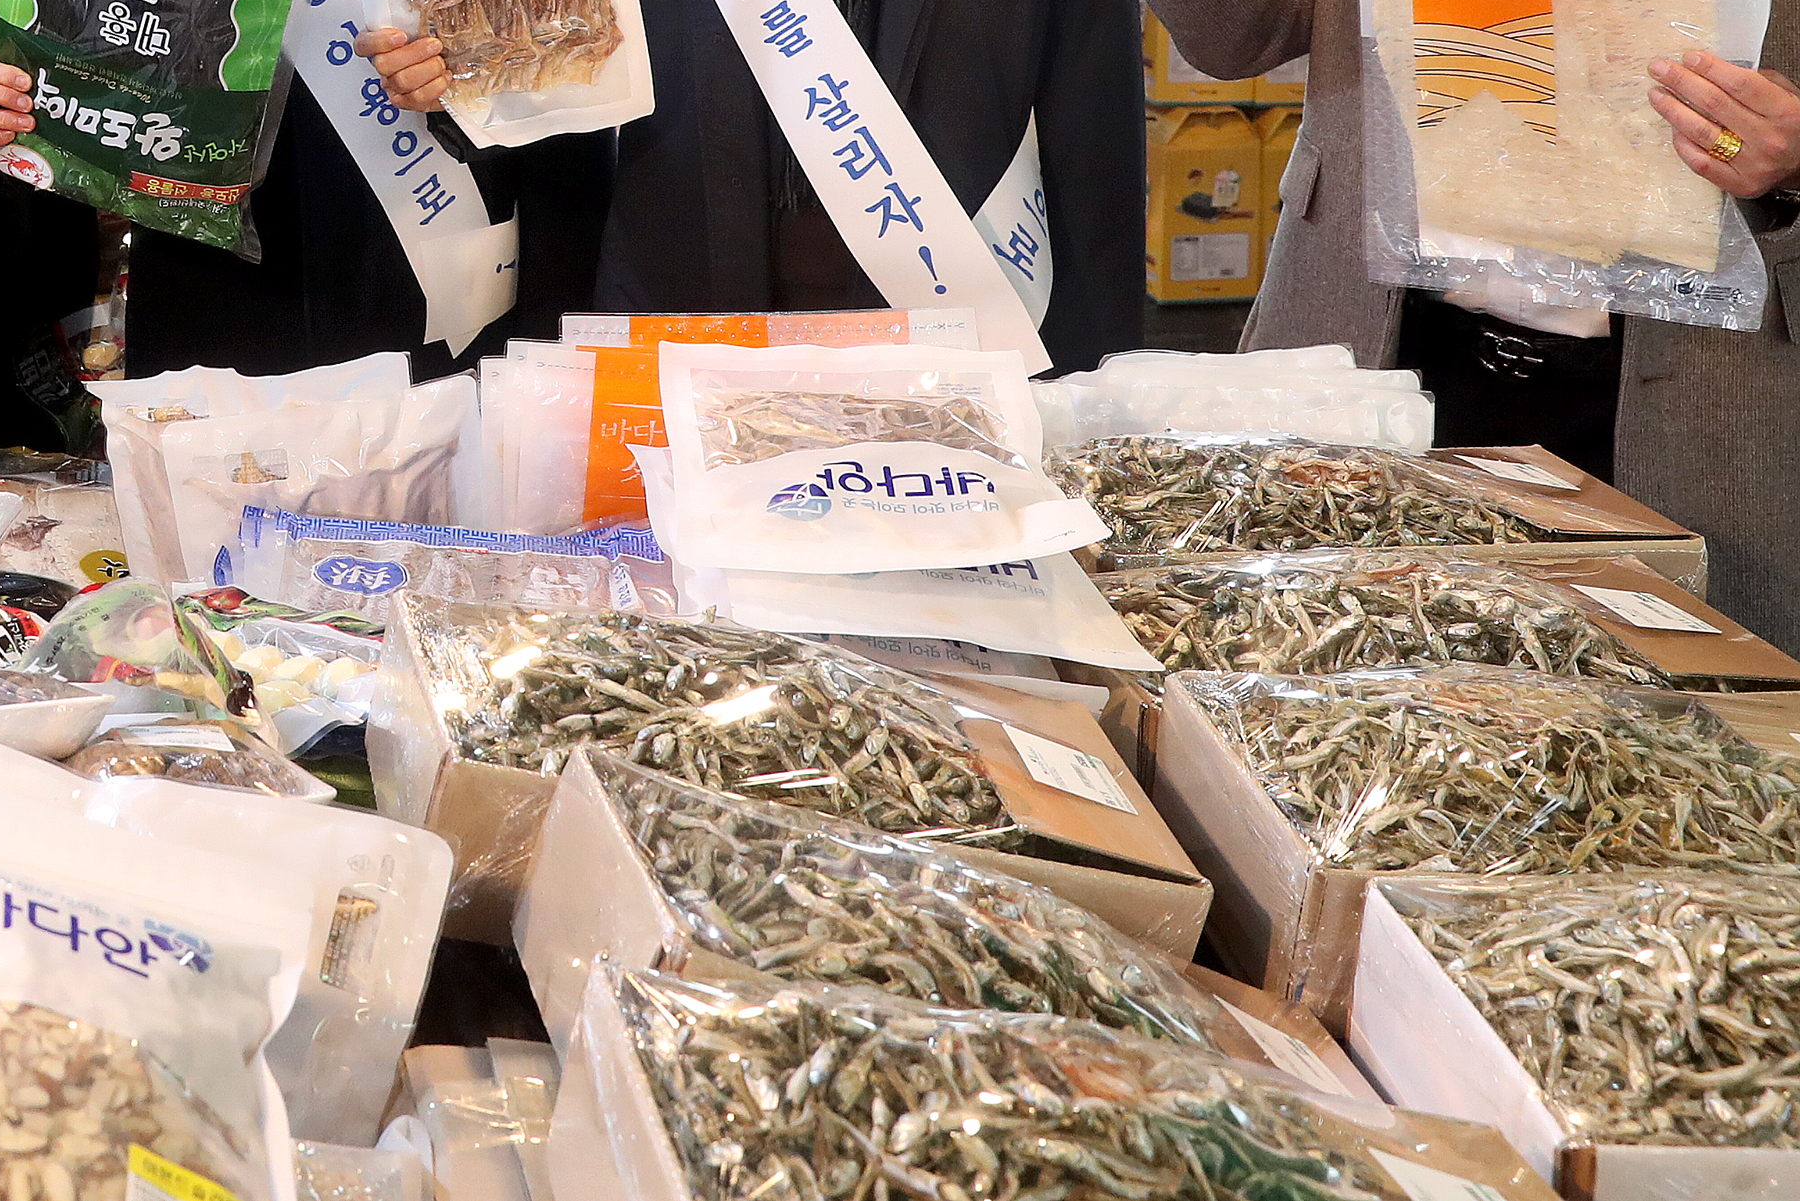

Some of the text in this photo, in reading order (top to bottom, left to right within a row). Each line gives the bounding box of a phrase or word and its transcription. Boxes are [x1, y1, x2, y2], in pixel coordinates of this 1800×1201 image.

[90, 74, 118, 90] Dried
[32, 66, 185, 163] 완도미역
[182, 138, 249, 164] 자연산
[142, 179, 189, 197] 선물용
[803, 72, 949, 297] 살리자!
[815, 459, 997, 500] 바다안
[859, 499, 908, 516] 모이는
[911, 500, 946, 516] 맛이
